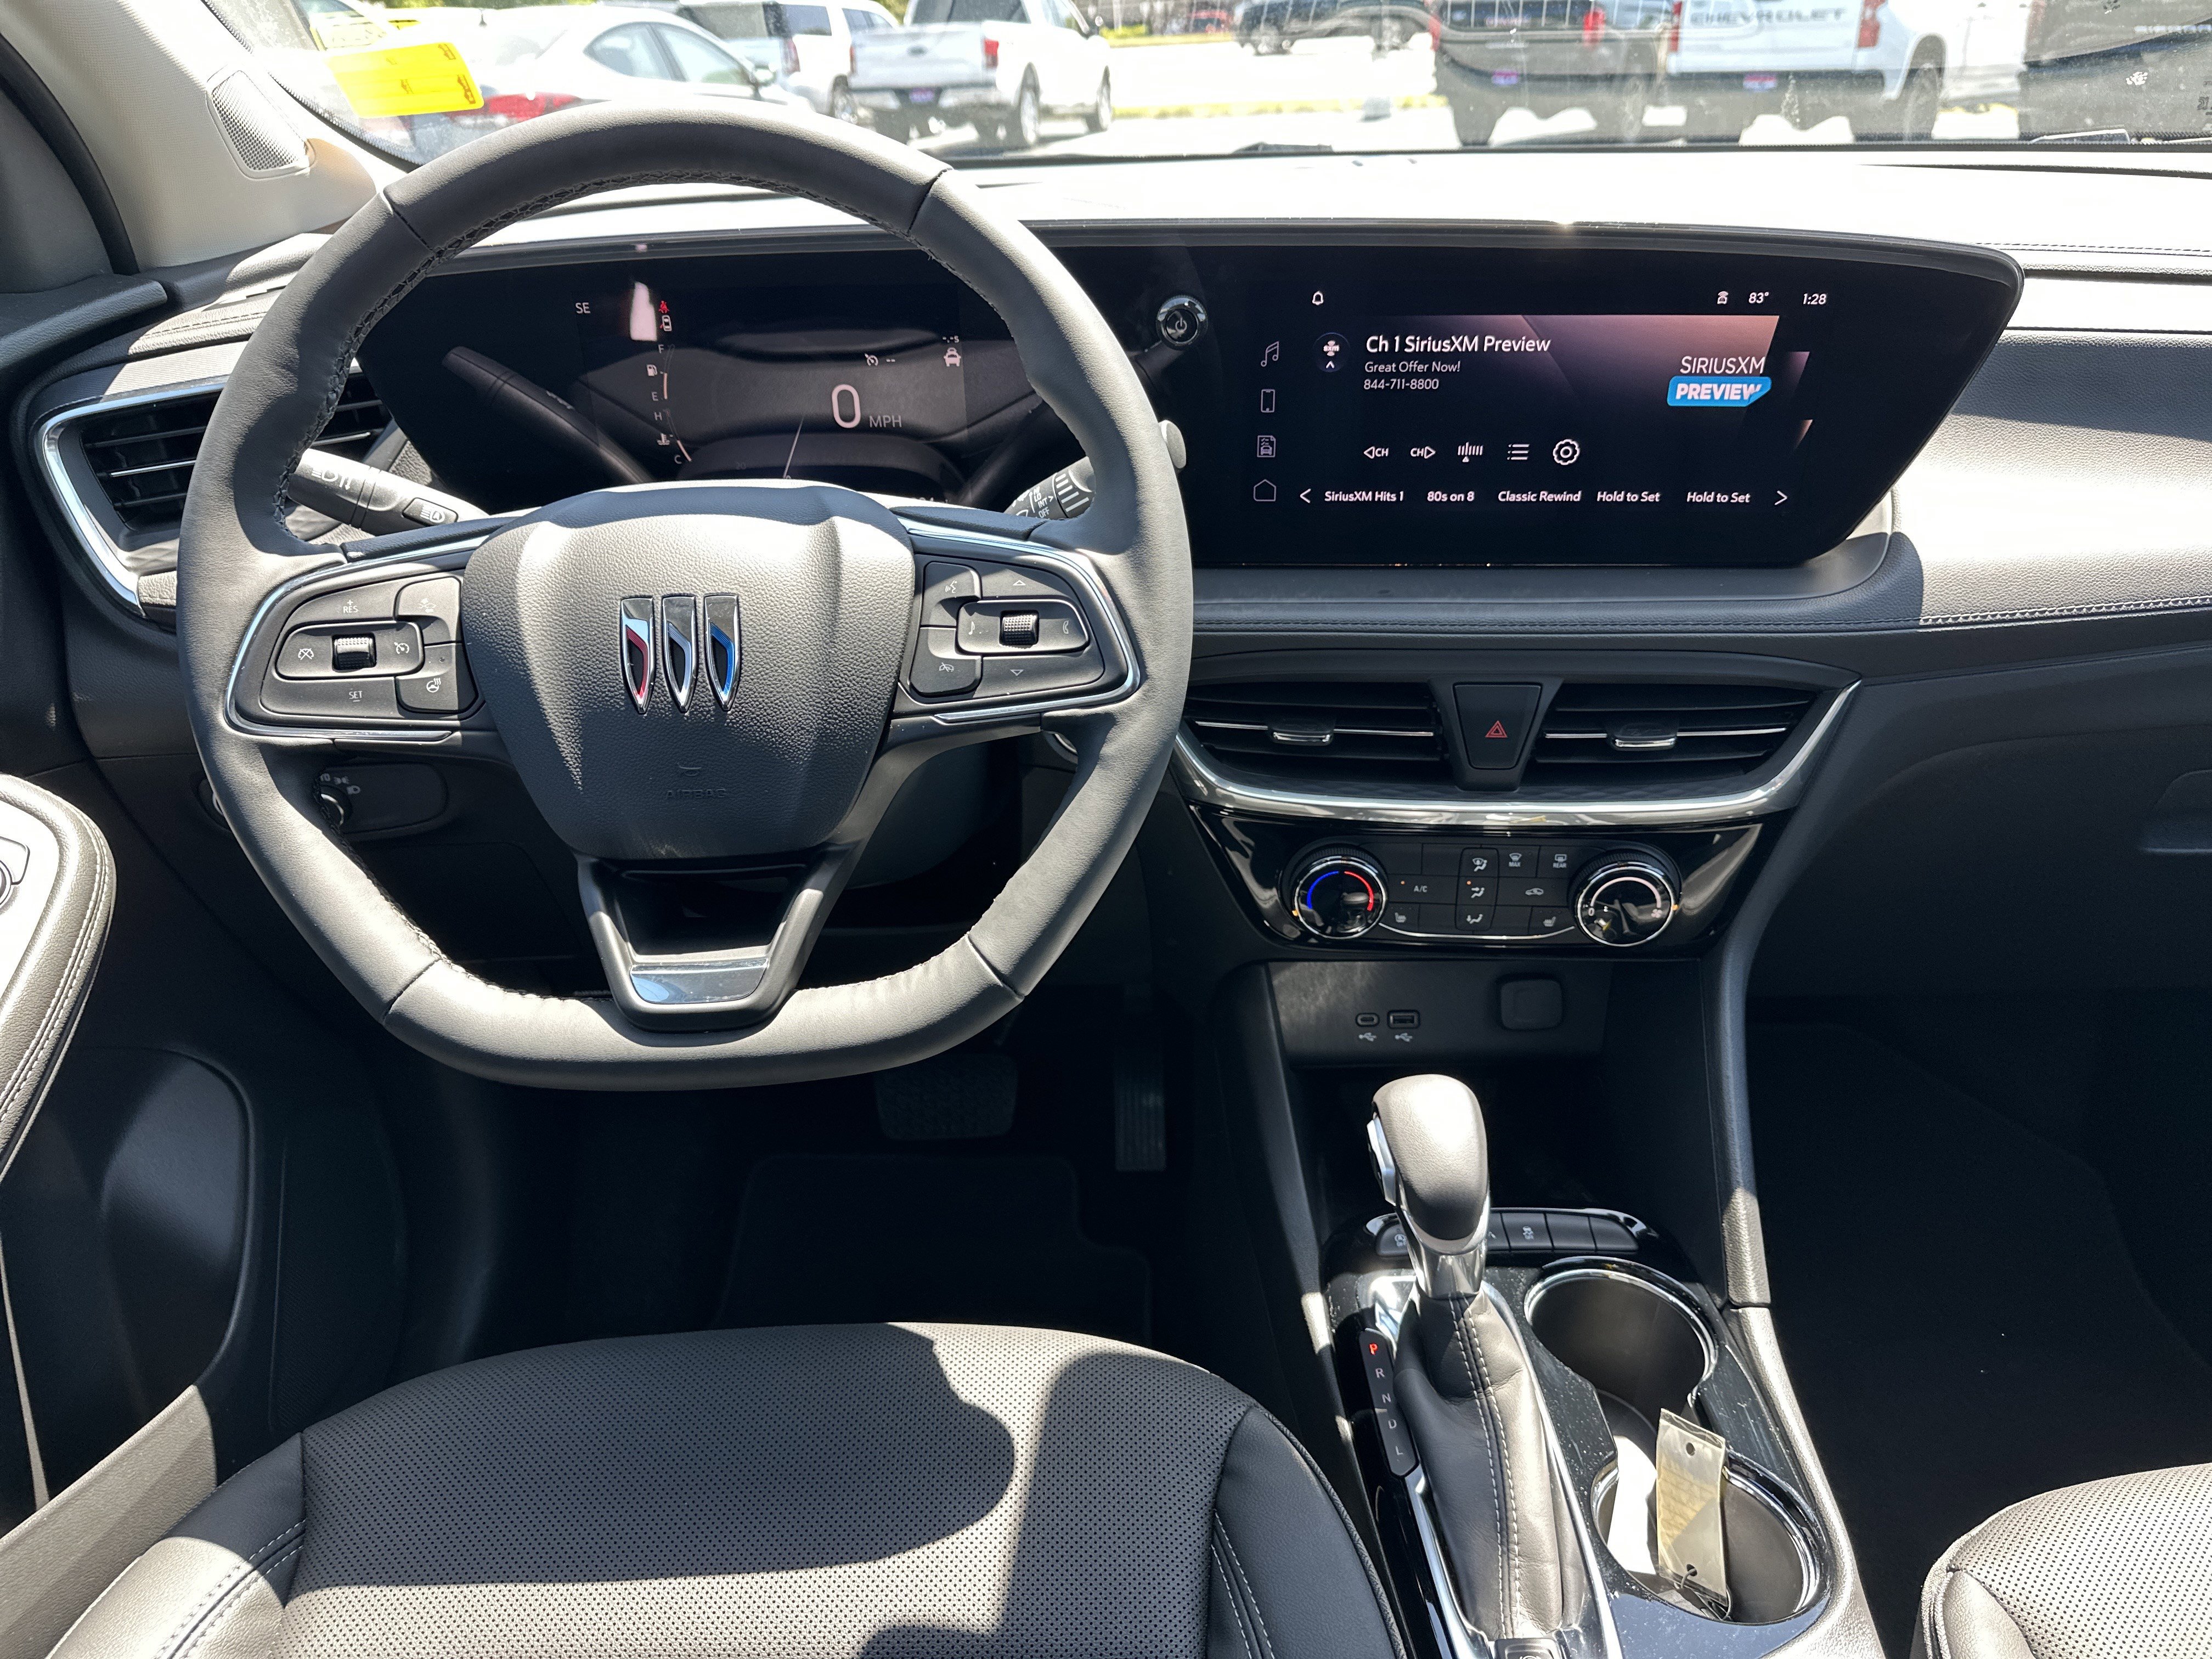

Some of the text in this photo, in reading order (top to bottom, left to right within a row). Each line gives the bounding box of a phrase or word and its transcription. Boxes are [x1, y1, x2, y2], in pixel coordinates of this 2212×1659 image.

[1690, 8, 1847, 25] CHEVROLET
[1748, 291, 1769, 304] 83°
[1803, 293, 1827, 304] 1:28
[575, 302, 591, 314] SE
[658, 344, 664, 354] F
[1366, 335, 1551, 353] Ch 1 SiriusXM Preview
[1364, 361, 1461, 373] Great Offer Now!
[1680, 356, 1767, 374] SIRIUSXM
[1363, 379, 1440, 390] 844-711-8800
[651, 392, 659, 401] E
[1675, 383, 1763, 400] PREVIEW
[831, 384, 902, 428] 0 MPH
[654, 411, 663, 421] H
[1375, 448, 1389, 457] CH
[1410, 448, 1424, 457] CH
[674, 455, 682, 464] C
[1034, 493, 1042, 502] LO
[1324, 491, 1404, 501] SiriusXM Hits 1
[1427, 491, 1448, 501] 80s
[1466, 491, 1475, 501] 8
[1498, 491, 1582, 501] Classic Rewind
[1596, 491, 1660, 501] Hold to Set
[1686, 492, 1751, 503] Hold to Set
[1038, 497, 1047, 508] INT
[1038, 507, 1050, 518] OFF
[343, 605, 358, 613] RES
[349, 691, 363, 699] SET
[1369, 1342, 1378, 1355] P
[1375, 1368, 1385, 1379] R
[1381, 1393, 1392, 1403] N
[1388, 1419, 1397, 1429] D
[1395, 1446, 1404, 1455] L
